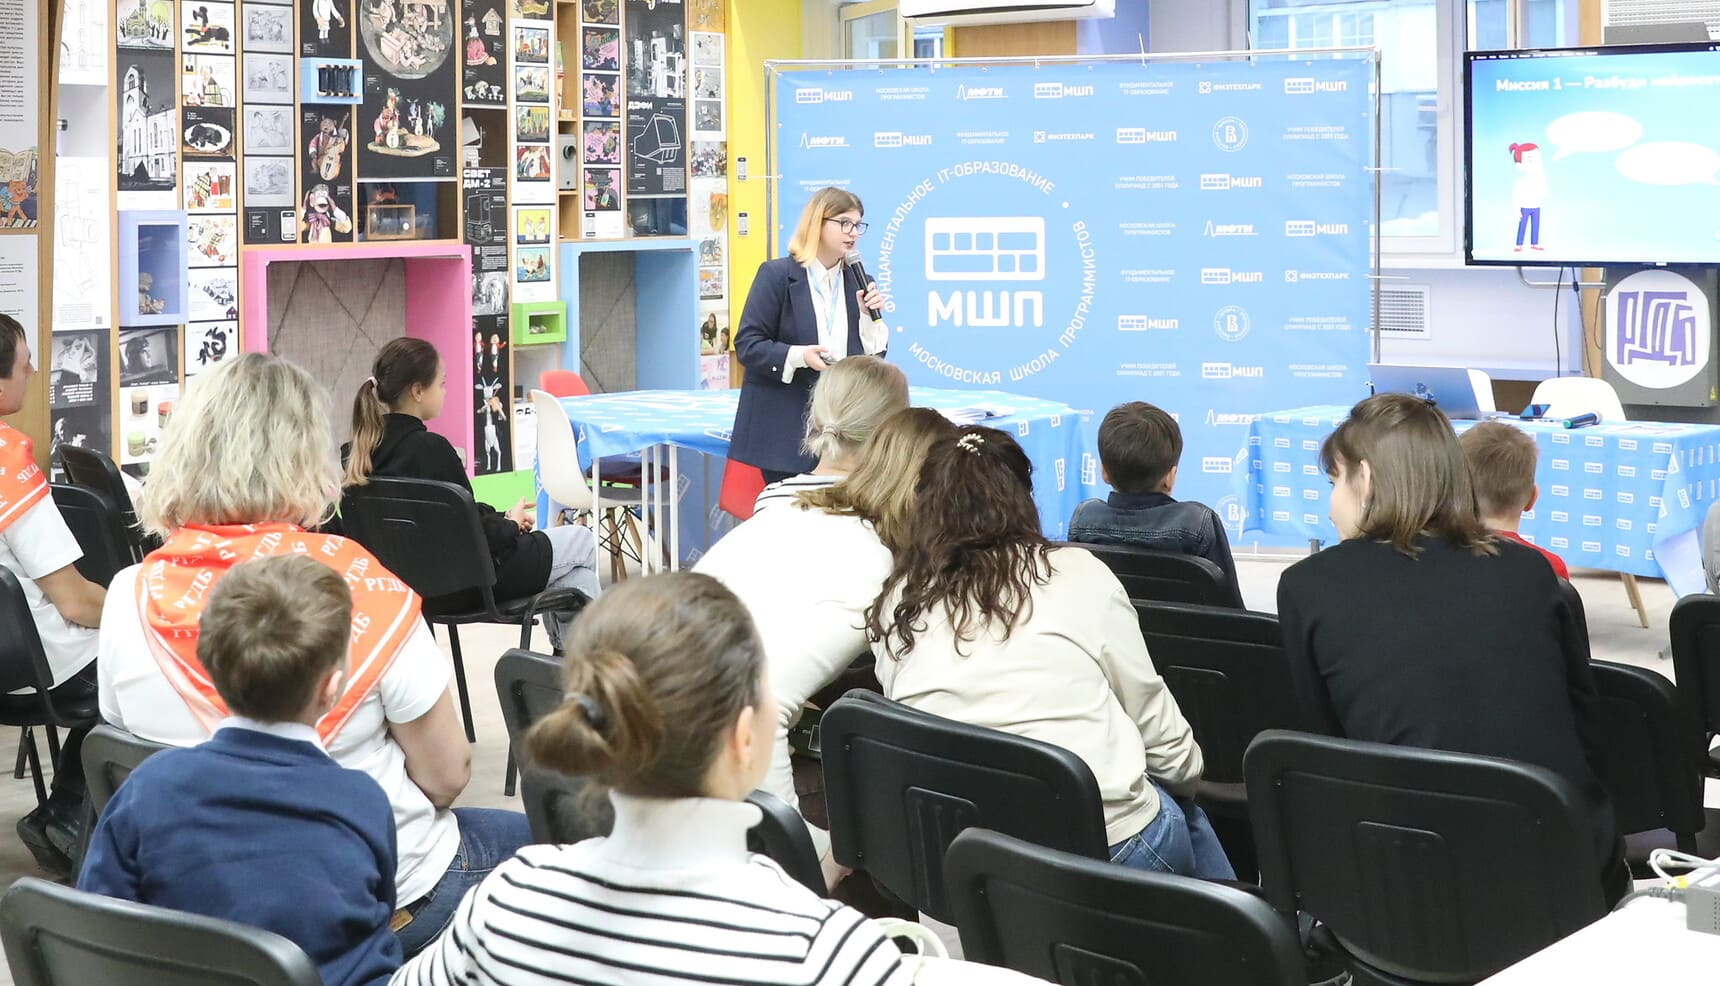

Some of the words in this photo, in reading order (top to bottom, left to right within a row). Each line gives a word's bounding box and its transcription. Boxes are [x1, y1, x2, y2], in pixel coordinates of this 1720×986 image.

[1316, 81, 1347, 91] МШП
[1553, 77, 1562, 90] 1
[824, 91, 852, 101] МШП
[1063, 86, 1094, 96] МШП
[903, 135, 932, 145] МШП
[1146, 131, 1177, 142] МШП
[463, 169, 491, 179] СВЕТ
[936, 160, 1056, 195] IT-ОБРАЗОВАНИЕ
[1231, 177, 1262, 188] МШП
[1316, 224, 1348, 235] МШП
[1231, 272, 1264, 282] МШП
[908, 341, 1001, 385] МОСКОВСКАЯ
[1008, 348, 1061, 382] ШКОЛА
[1058, 220, 1097, 349] ПРОГРАММИСТОВ
[928, 290, 1043, 327] МШП
[1148, 319, 1178, 329] МШП
[1232, 367, 1264, 377] МШП
[321, 535, 346, 557] РГД
[172, 568, 213, 609] РГДБ
[364, 577, 407, 593] РГДБ
